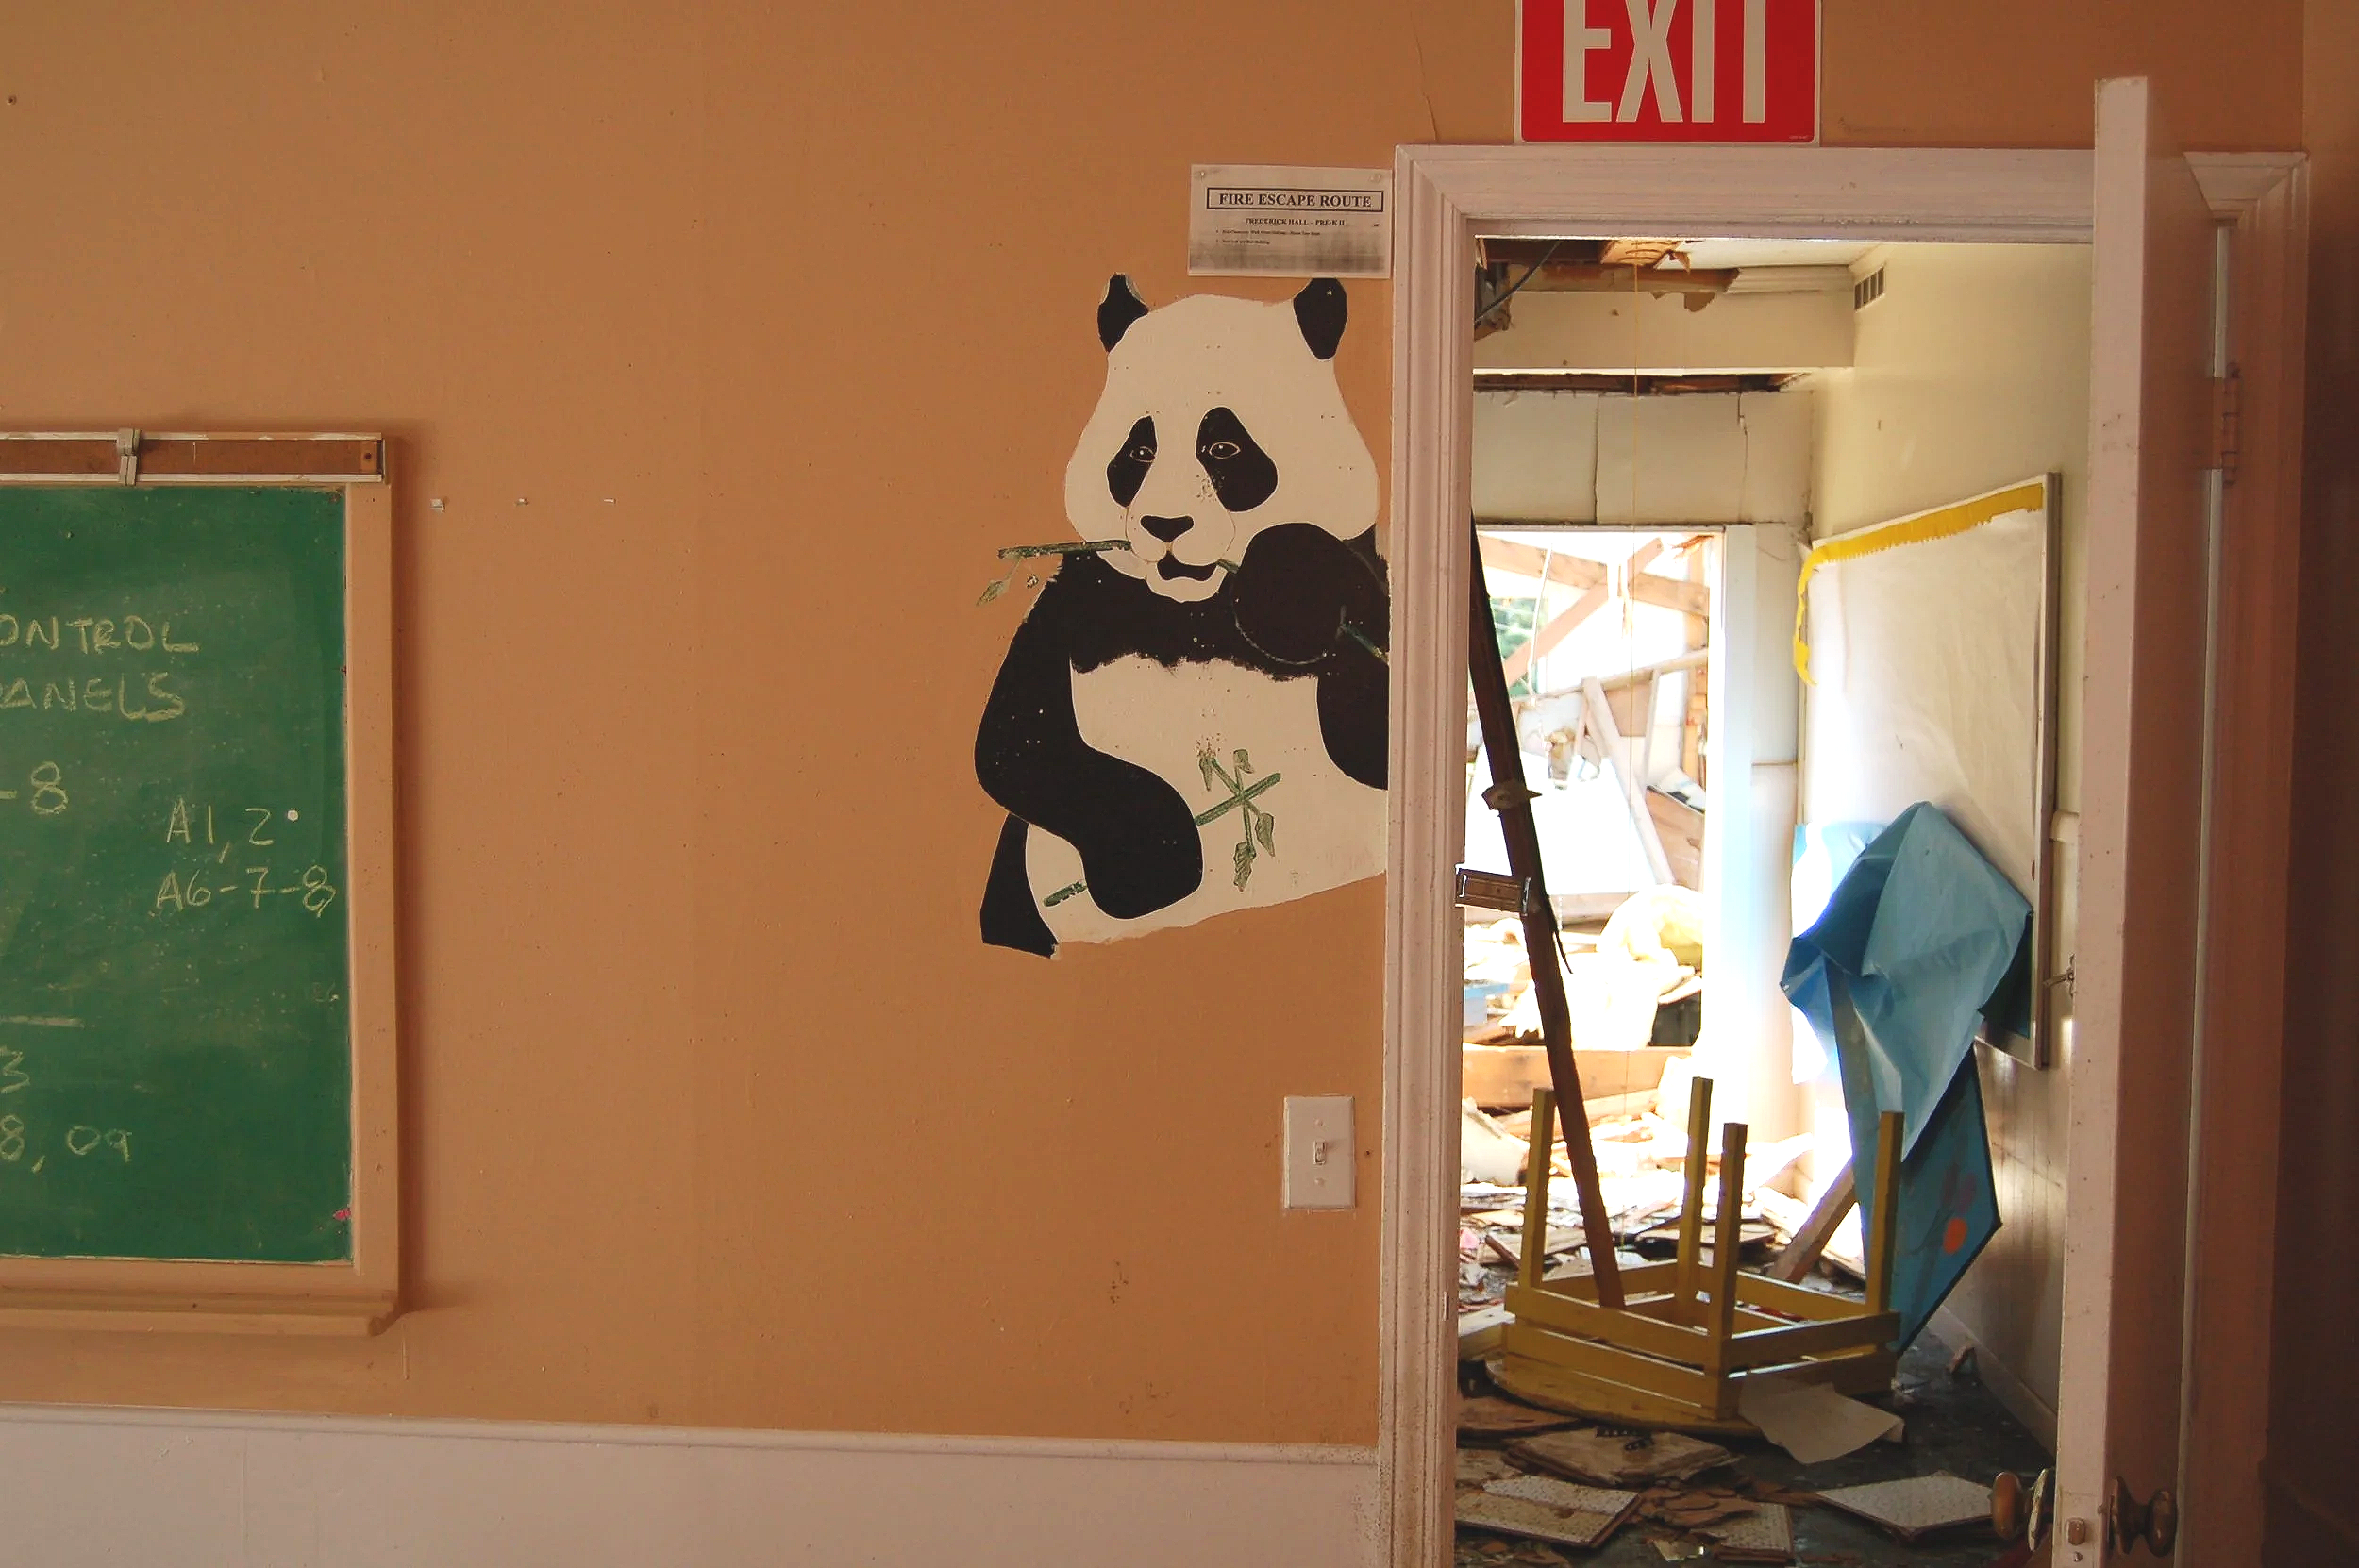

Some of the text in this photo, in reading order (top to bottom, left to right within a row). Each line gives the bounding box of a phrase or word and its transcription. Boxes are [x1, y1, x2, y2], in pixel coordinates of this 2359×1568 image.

[1562, 0, 1766, 124] EXIT
[1218, 192, 1372, 208] FIRE ESCAPE ROUTE
[1245, 217, 1287, 225] FREDERICK
[1288, 218, 1309, 226] HALL
[0, 672, 187, 724] ANELS
[155, 864, 337, 919] A6-7-8
